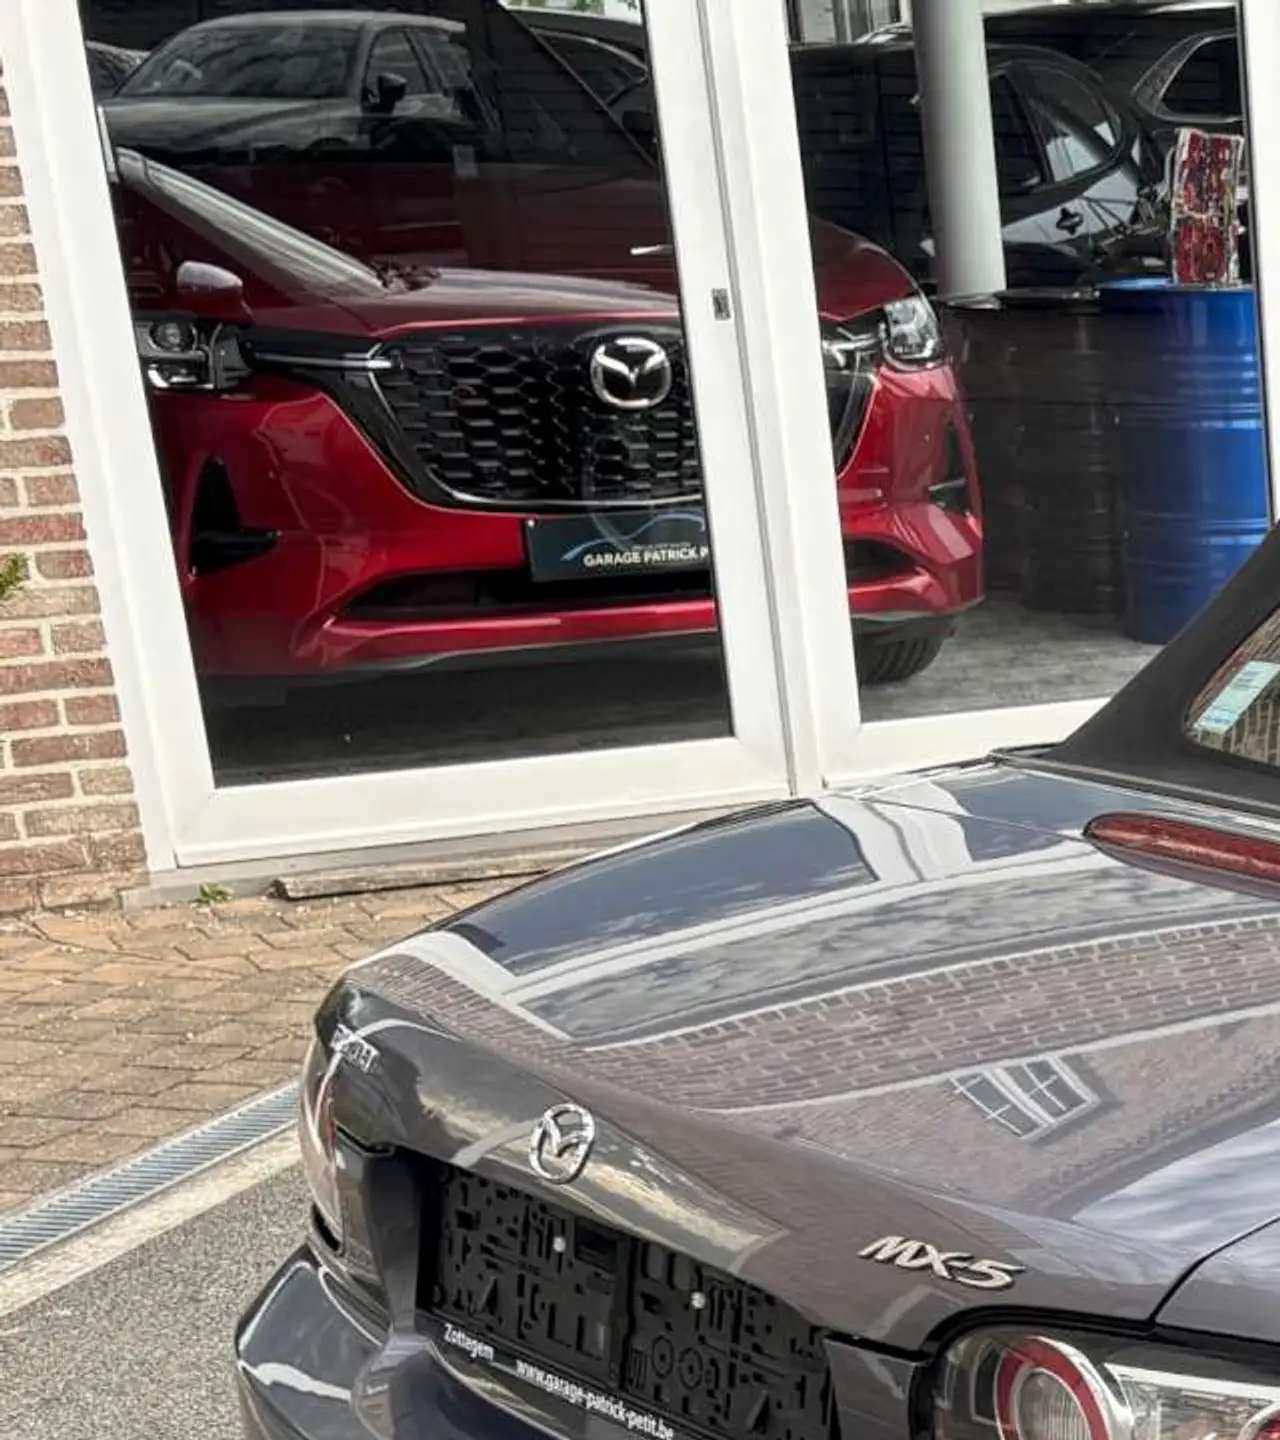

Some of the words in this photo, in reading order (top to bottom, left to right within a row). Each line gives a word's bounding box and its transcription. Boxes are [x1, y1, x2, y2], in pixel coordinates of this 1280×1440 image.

[583, 551, 641, 567] GARAGE
[644, 546, 697, 563] PATRICK
[857, 1235, 1027, 1289] MX-5
